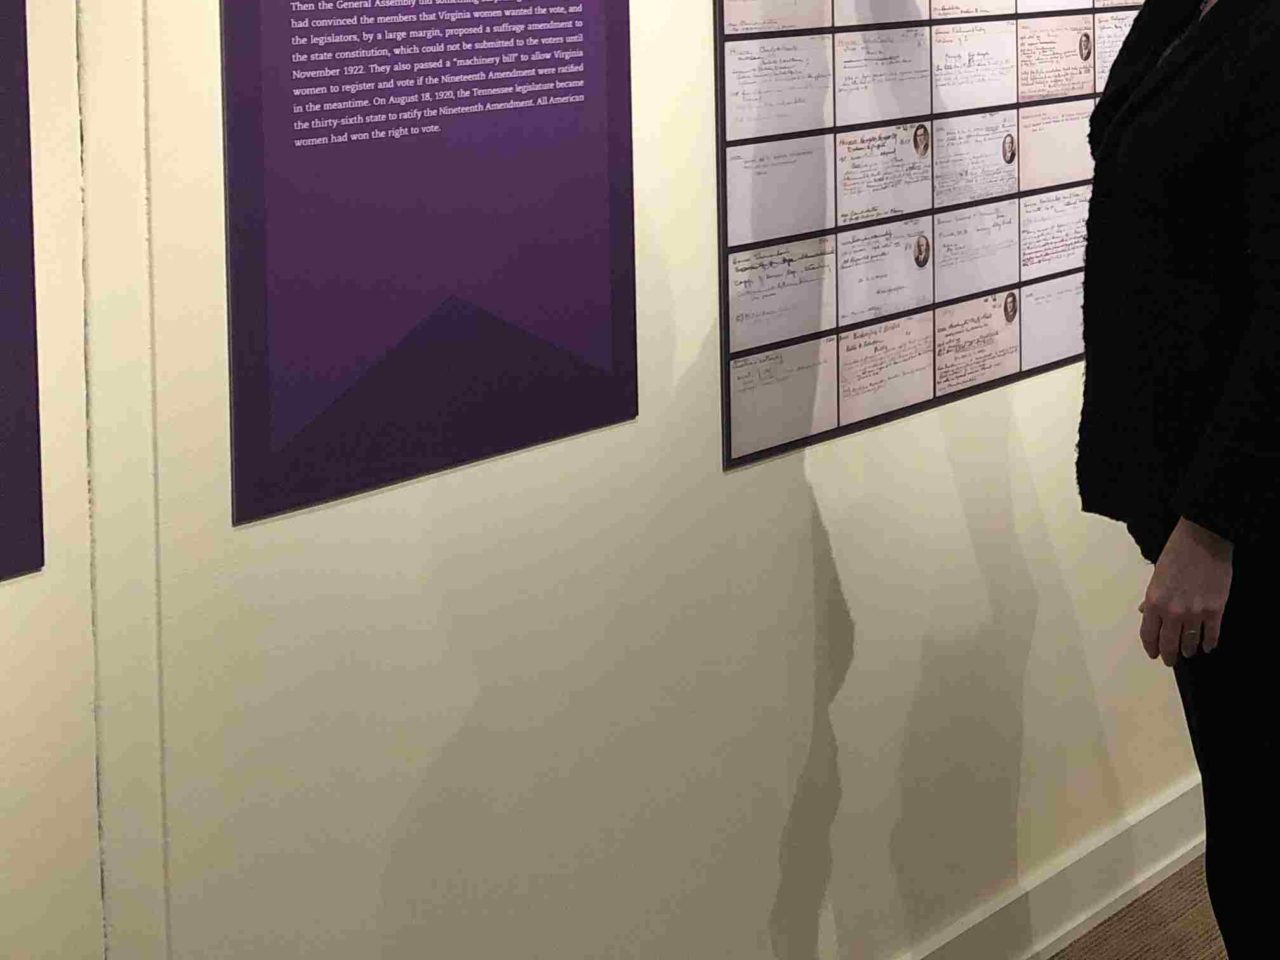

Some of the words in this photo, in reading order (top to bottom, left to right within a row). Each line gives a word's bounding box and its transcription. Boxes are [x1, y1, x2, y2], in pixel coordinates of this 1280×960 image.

[289, 0, 316, 11] Then
[317, 0, 334, 10] the
[290, 17, 309, 28] had
[310, 14, 358, 27] convinced
[359, 14, 375, 25] the
[376, 12, 418, 24] members
[418, 11, 437, 21] that
[437, 9, 472, 22] Virginia
[472, 9, 503, 18] women
[503, 5, 533, 16] wanted
[533, 5, 548, 15] the
[548, 5, 568, 14] vote,
[567, 3, 583, 13] and
[292, 103, 304, 113] in
[304, 101, 322, 112] the
[322, 98, 371, 111] meantime.
[372, 96, 387, 106] On
[387, 93, 419, 106] August
[420, 91, 433, 102] 18,
[434, 89, 456, 100] 1920,
[456, 88, 471, 98] the
[471, 86, 514, 97] Tennessee
[514, 81, 555, 95] legislature
[554, 79, 585, 89] became
[293, 136, 329, 147] women
[330, 131, 348, 143] had
[349, 132, 370, 141] won
[370, 128, 387, 139] the
[387, 126, 409, 139] right
[410, 126, 420, 135] to
[420, 124, 441, 133] vote.
